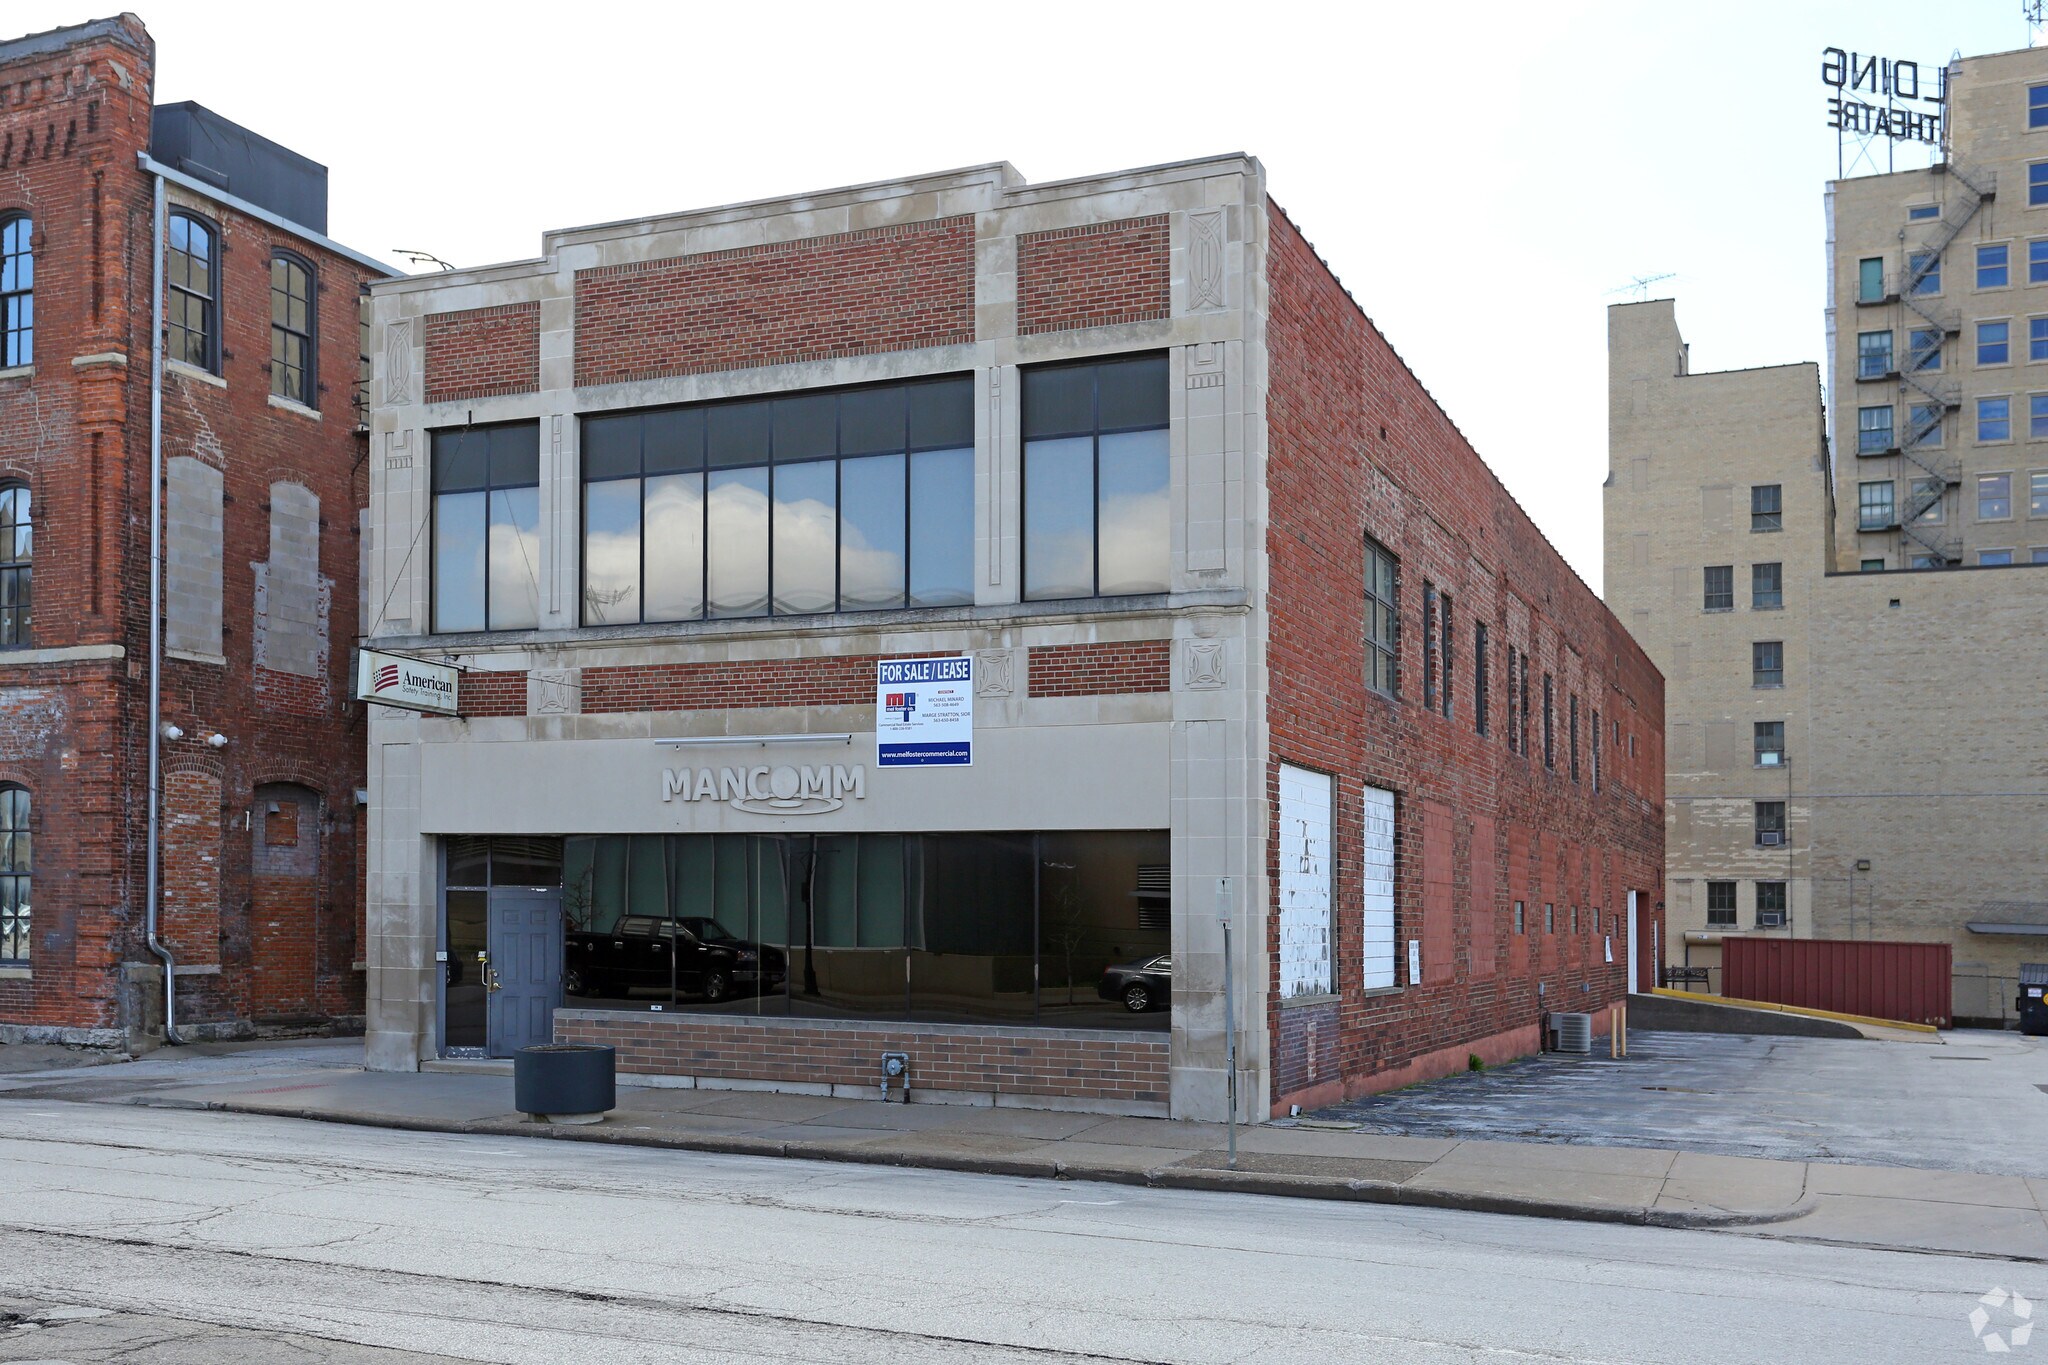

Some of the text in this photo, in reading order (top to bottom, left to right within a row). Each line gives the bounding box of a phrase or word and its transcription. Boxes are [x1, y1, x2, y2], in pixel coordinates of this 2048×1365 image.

[402, 670, 452, 693] American
[881, 664, 902, 682] FOR
[904, 663, 929, 681] SALE
[937, 661, 969, 679] LEASE
[402, 685, 419, 696] Safety
[881, 750, 968, 758] www.melfostercommercial.com
[662, 763, 866, 802] MANCOMM
